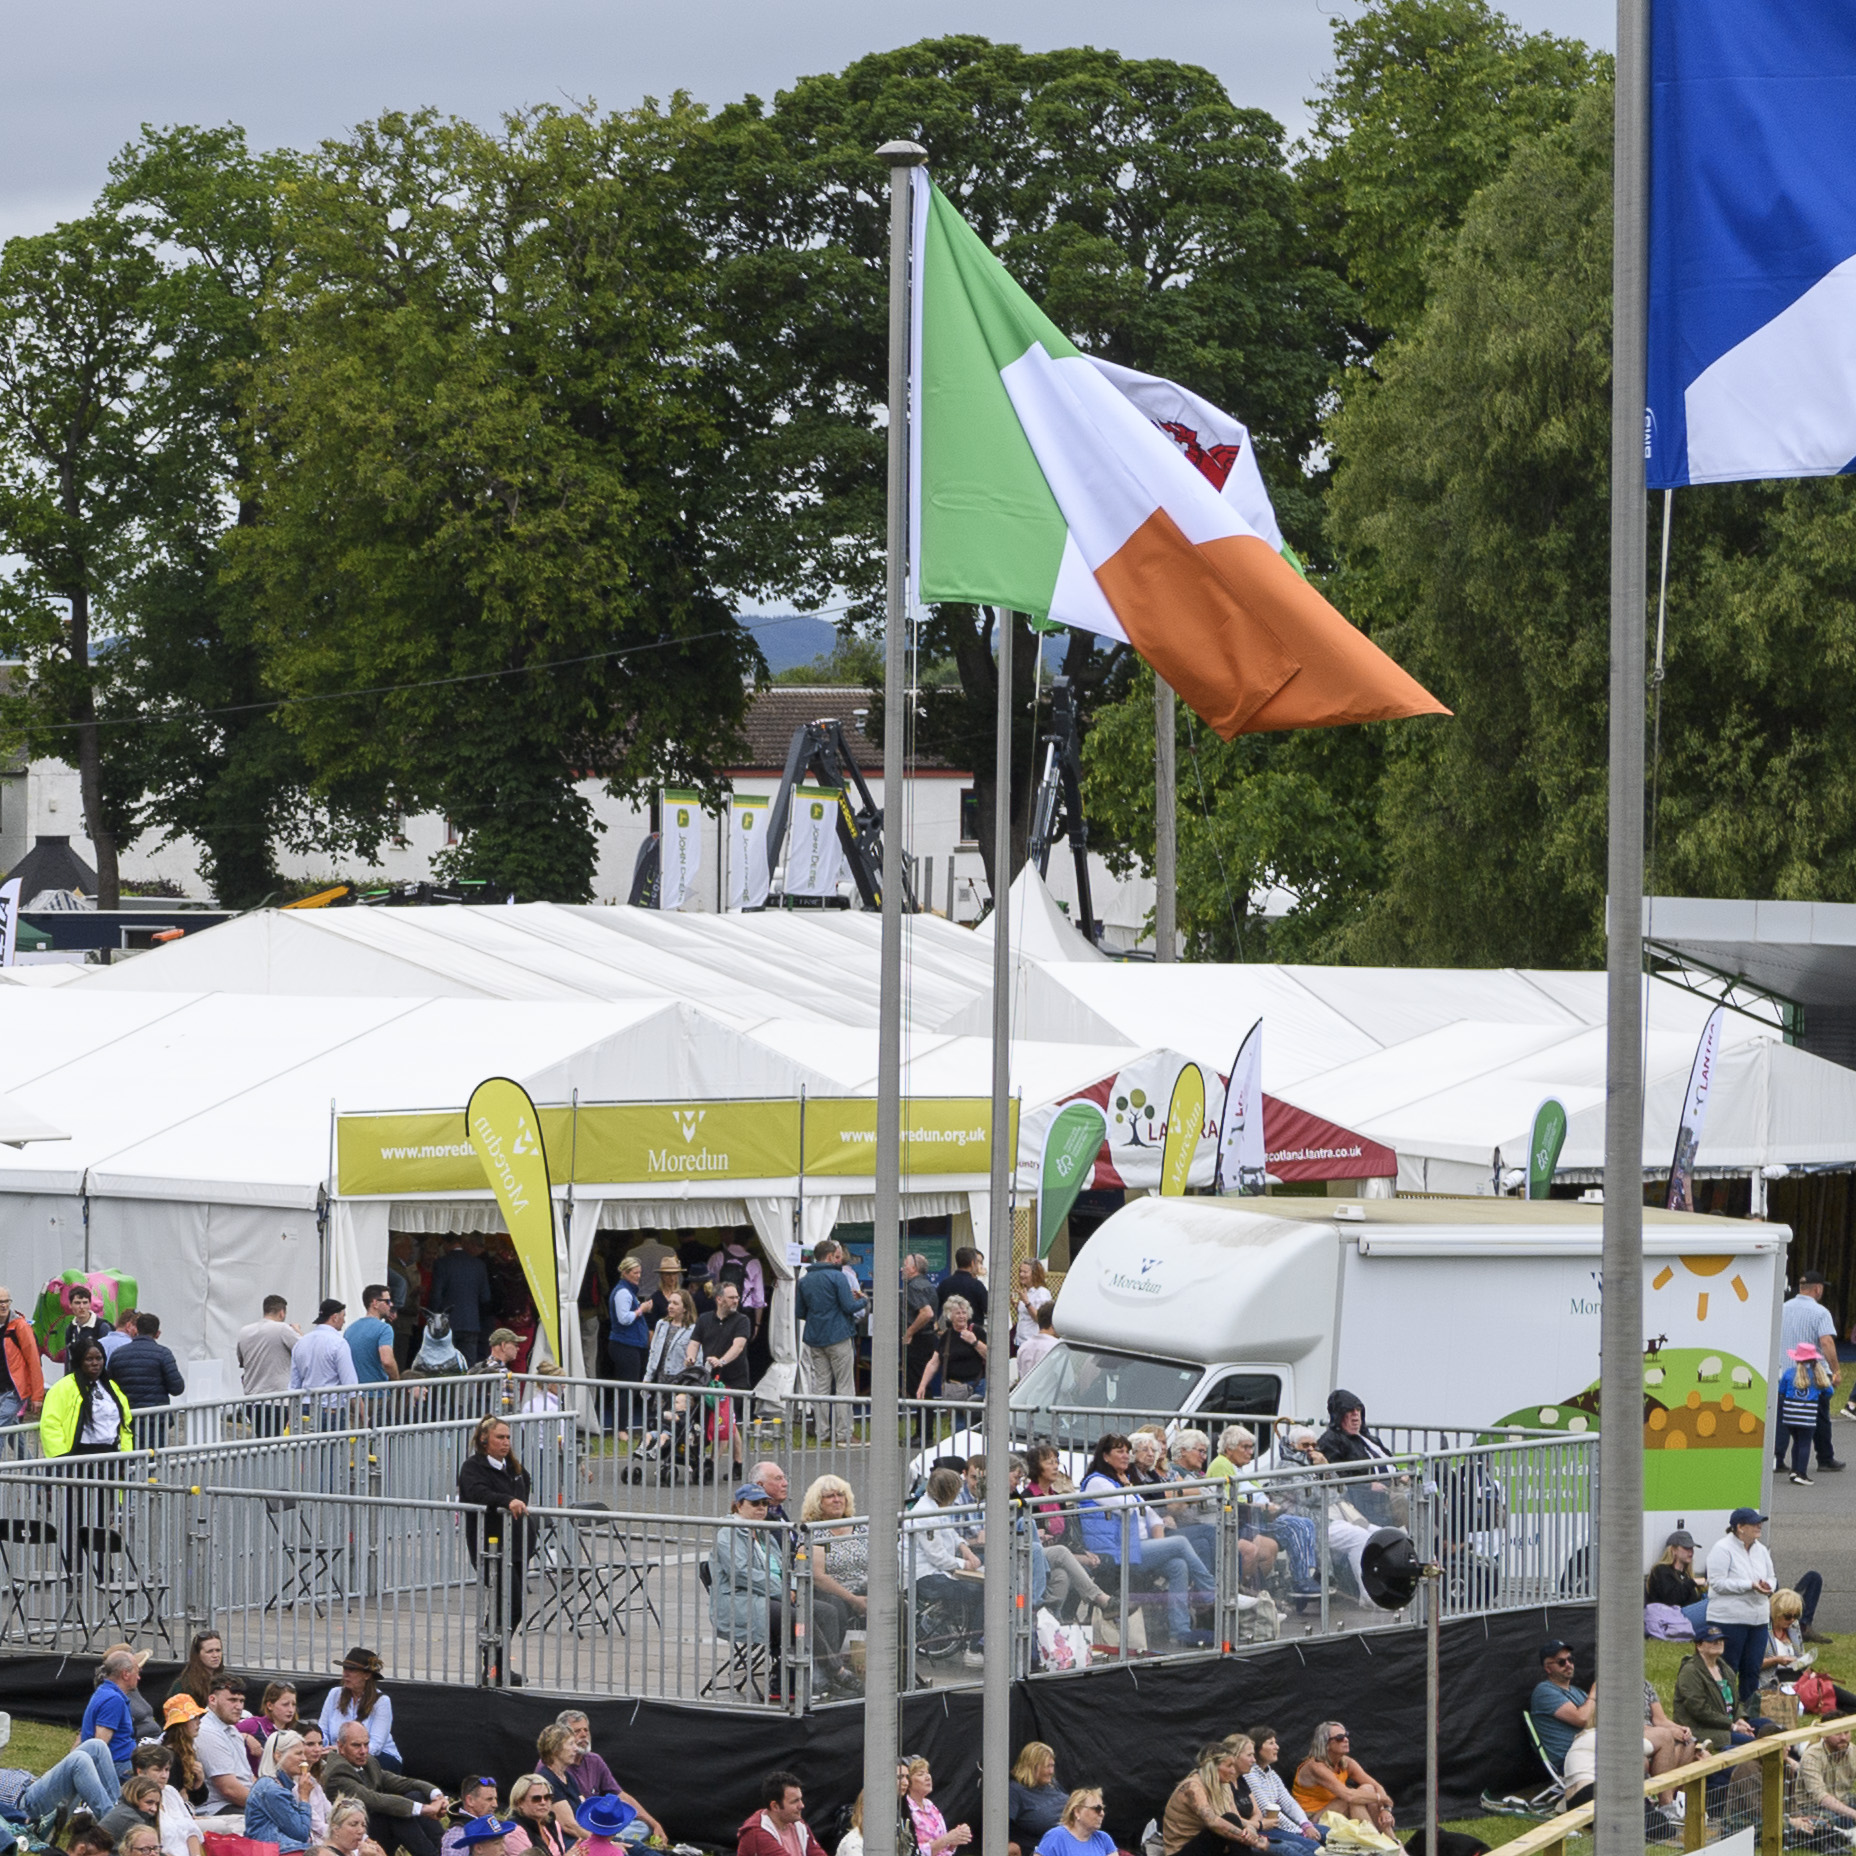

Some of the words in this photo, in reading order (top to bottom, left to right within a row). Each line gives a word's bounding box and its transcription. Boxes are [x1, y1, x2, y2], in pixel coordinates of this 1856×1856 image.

[840, 1127, 986, 1146] www.redun.org.uk
[1171, 1100, 1203, 1191] Moredun
[648, 1149, 729, 1172] Moredun
[1109, 1273, 1162, 1294] Moredun
